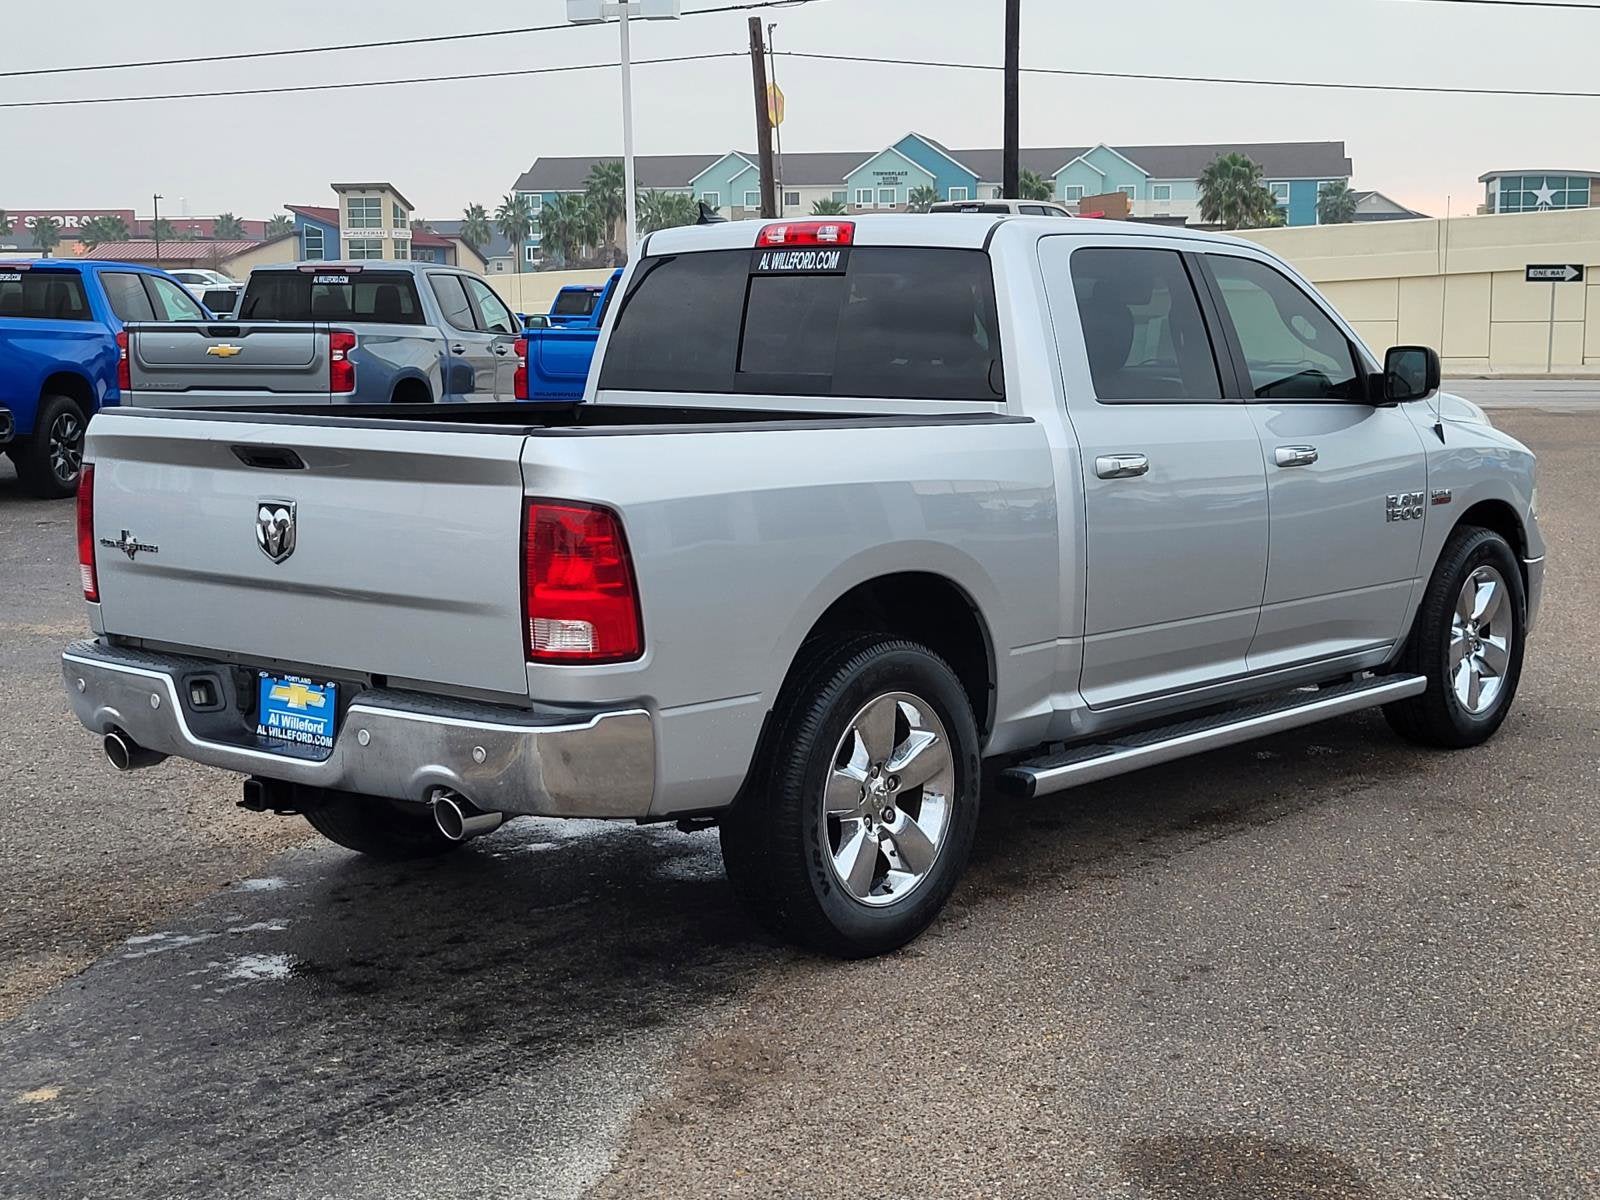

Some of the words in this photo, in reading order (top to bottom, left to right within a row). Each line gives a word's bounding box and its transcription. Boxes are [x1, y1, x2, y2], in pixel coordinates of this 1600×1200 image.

[758, 252, 770, 270] AL
[771, 251, 840, 270] WILLEFORD.COM
[1386, 492, 1424, 508] RAM
[1386, 506, 1424, 522] 1500
[284, 675, 312, 685] PORTLAND
[281, 715, 324, 735] Willeford
[256, 724, 268, 735] AL
[268, 726, 333, 747] WILLEFORD.COM
